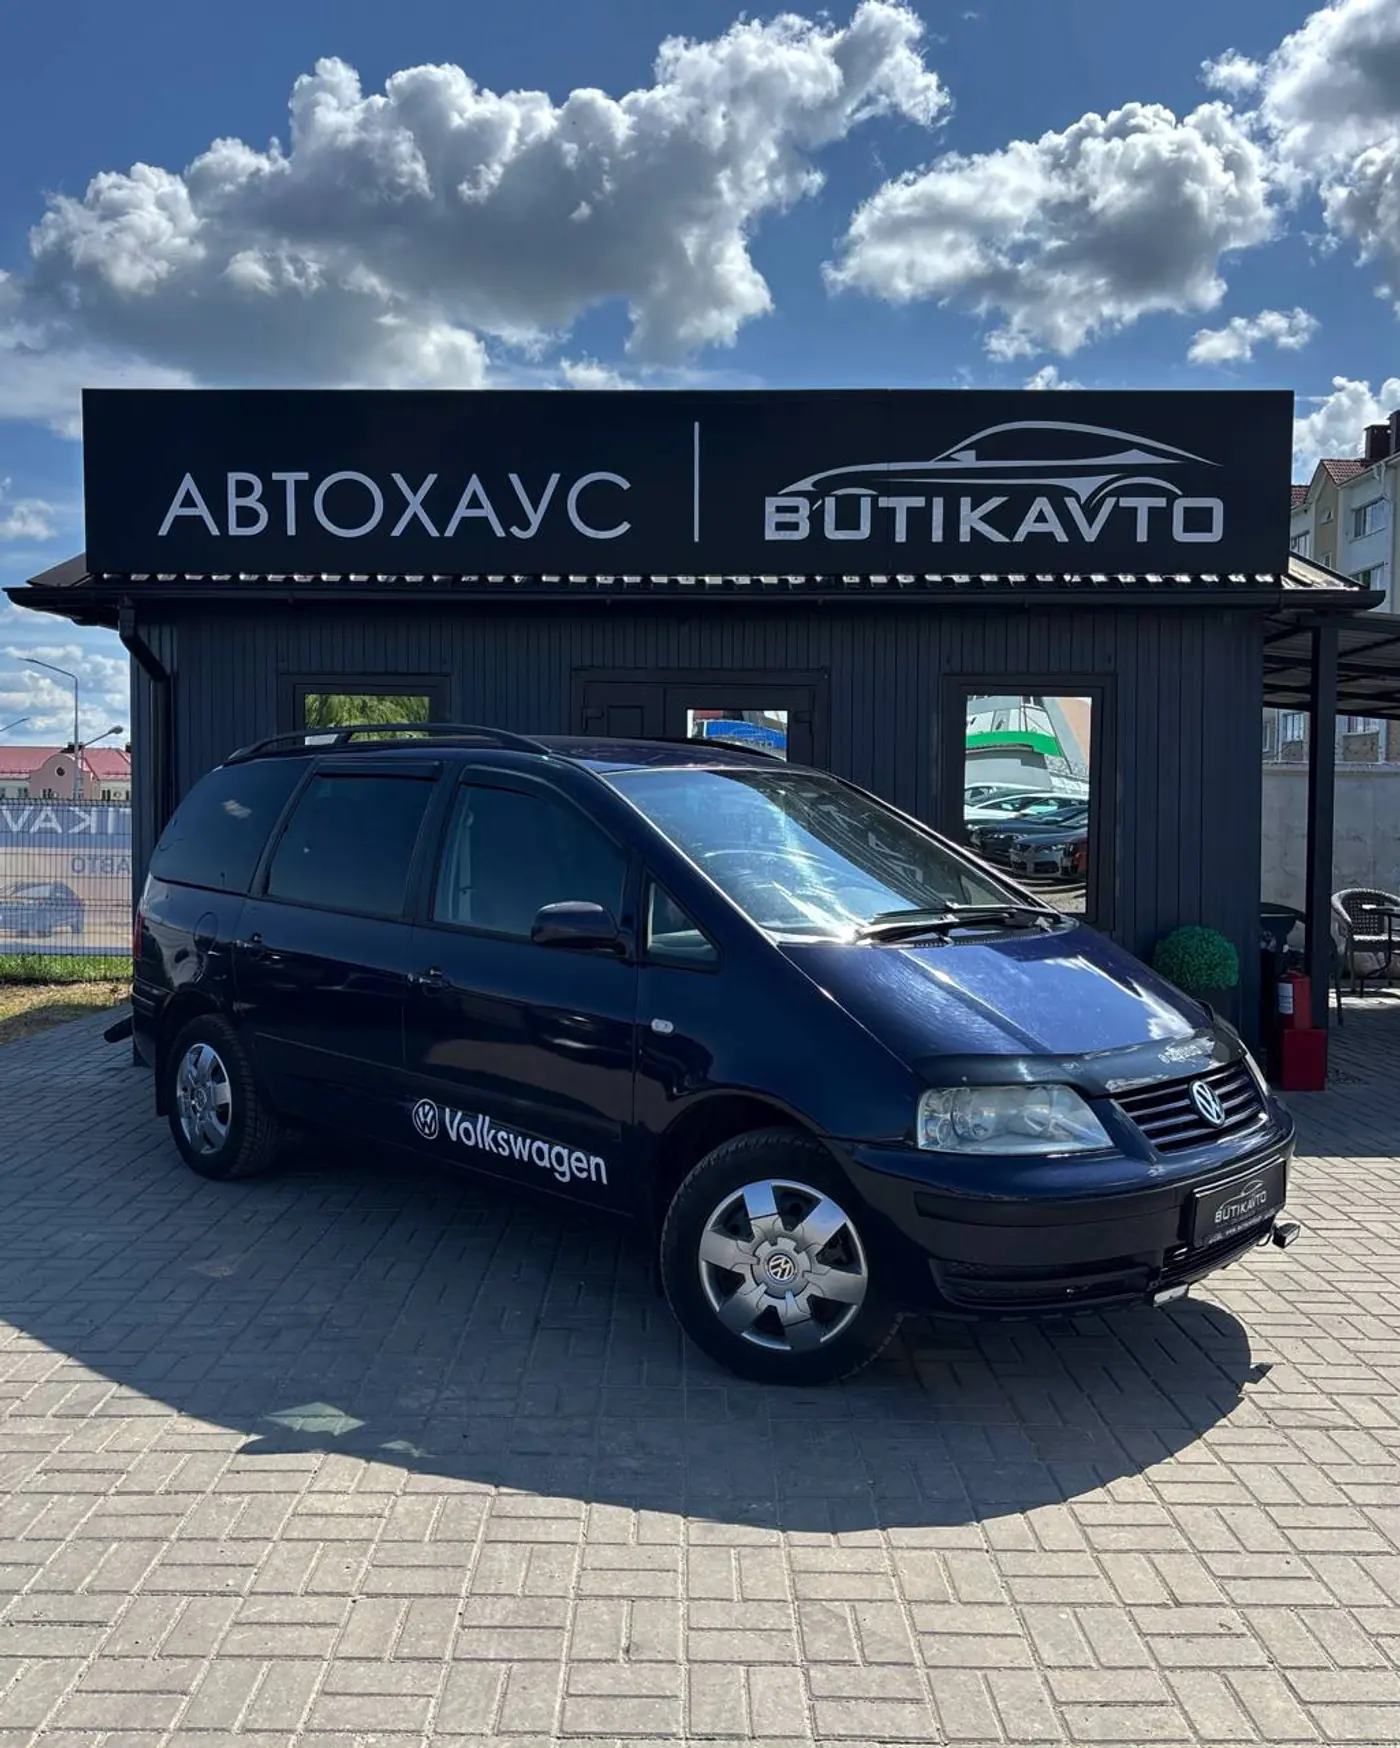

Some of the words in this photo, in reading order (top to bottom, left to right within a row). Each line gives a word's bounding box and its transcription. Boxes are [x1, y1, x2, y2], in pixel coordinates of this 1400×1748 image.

[157, 470, 632, 538] АВТОХАУС
[764, 496, 1223, 542] BUTIKAVTO
[445, 1107, 608, 1185] Volkswagen
[1214, 1190, 1267, 1223] BUTIKAVTO
